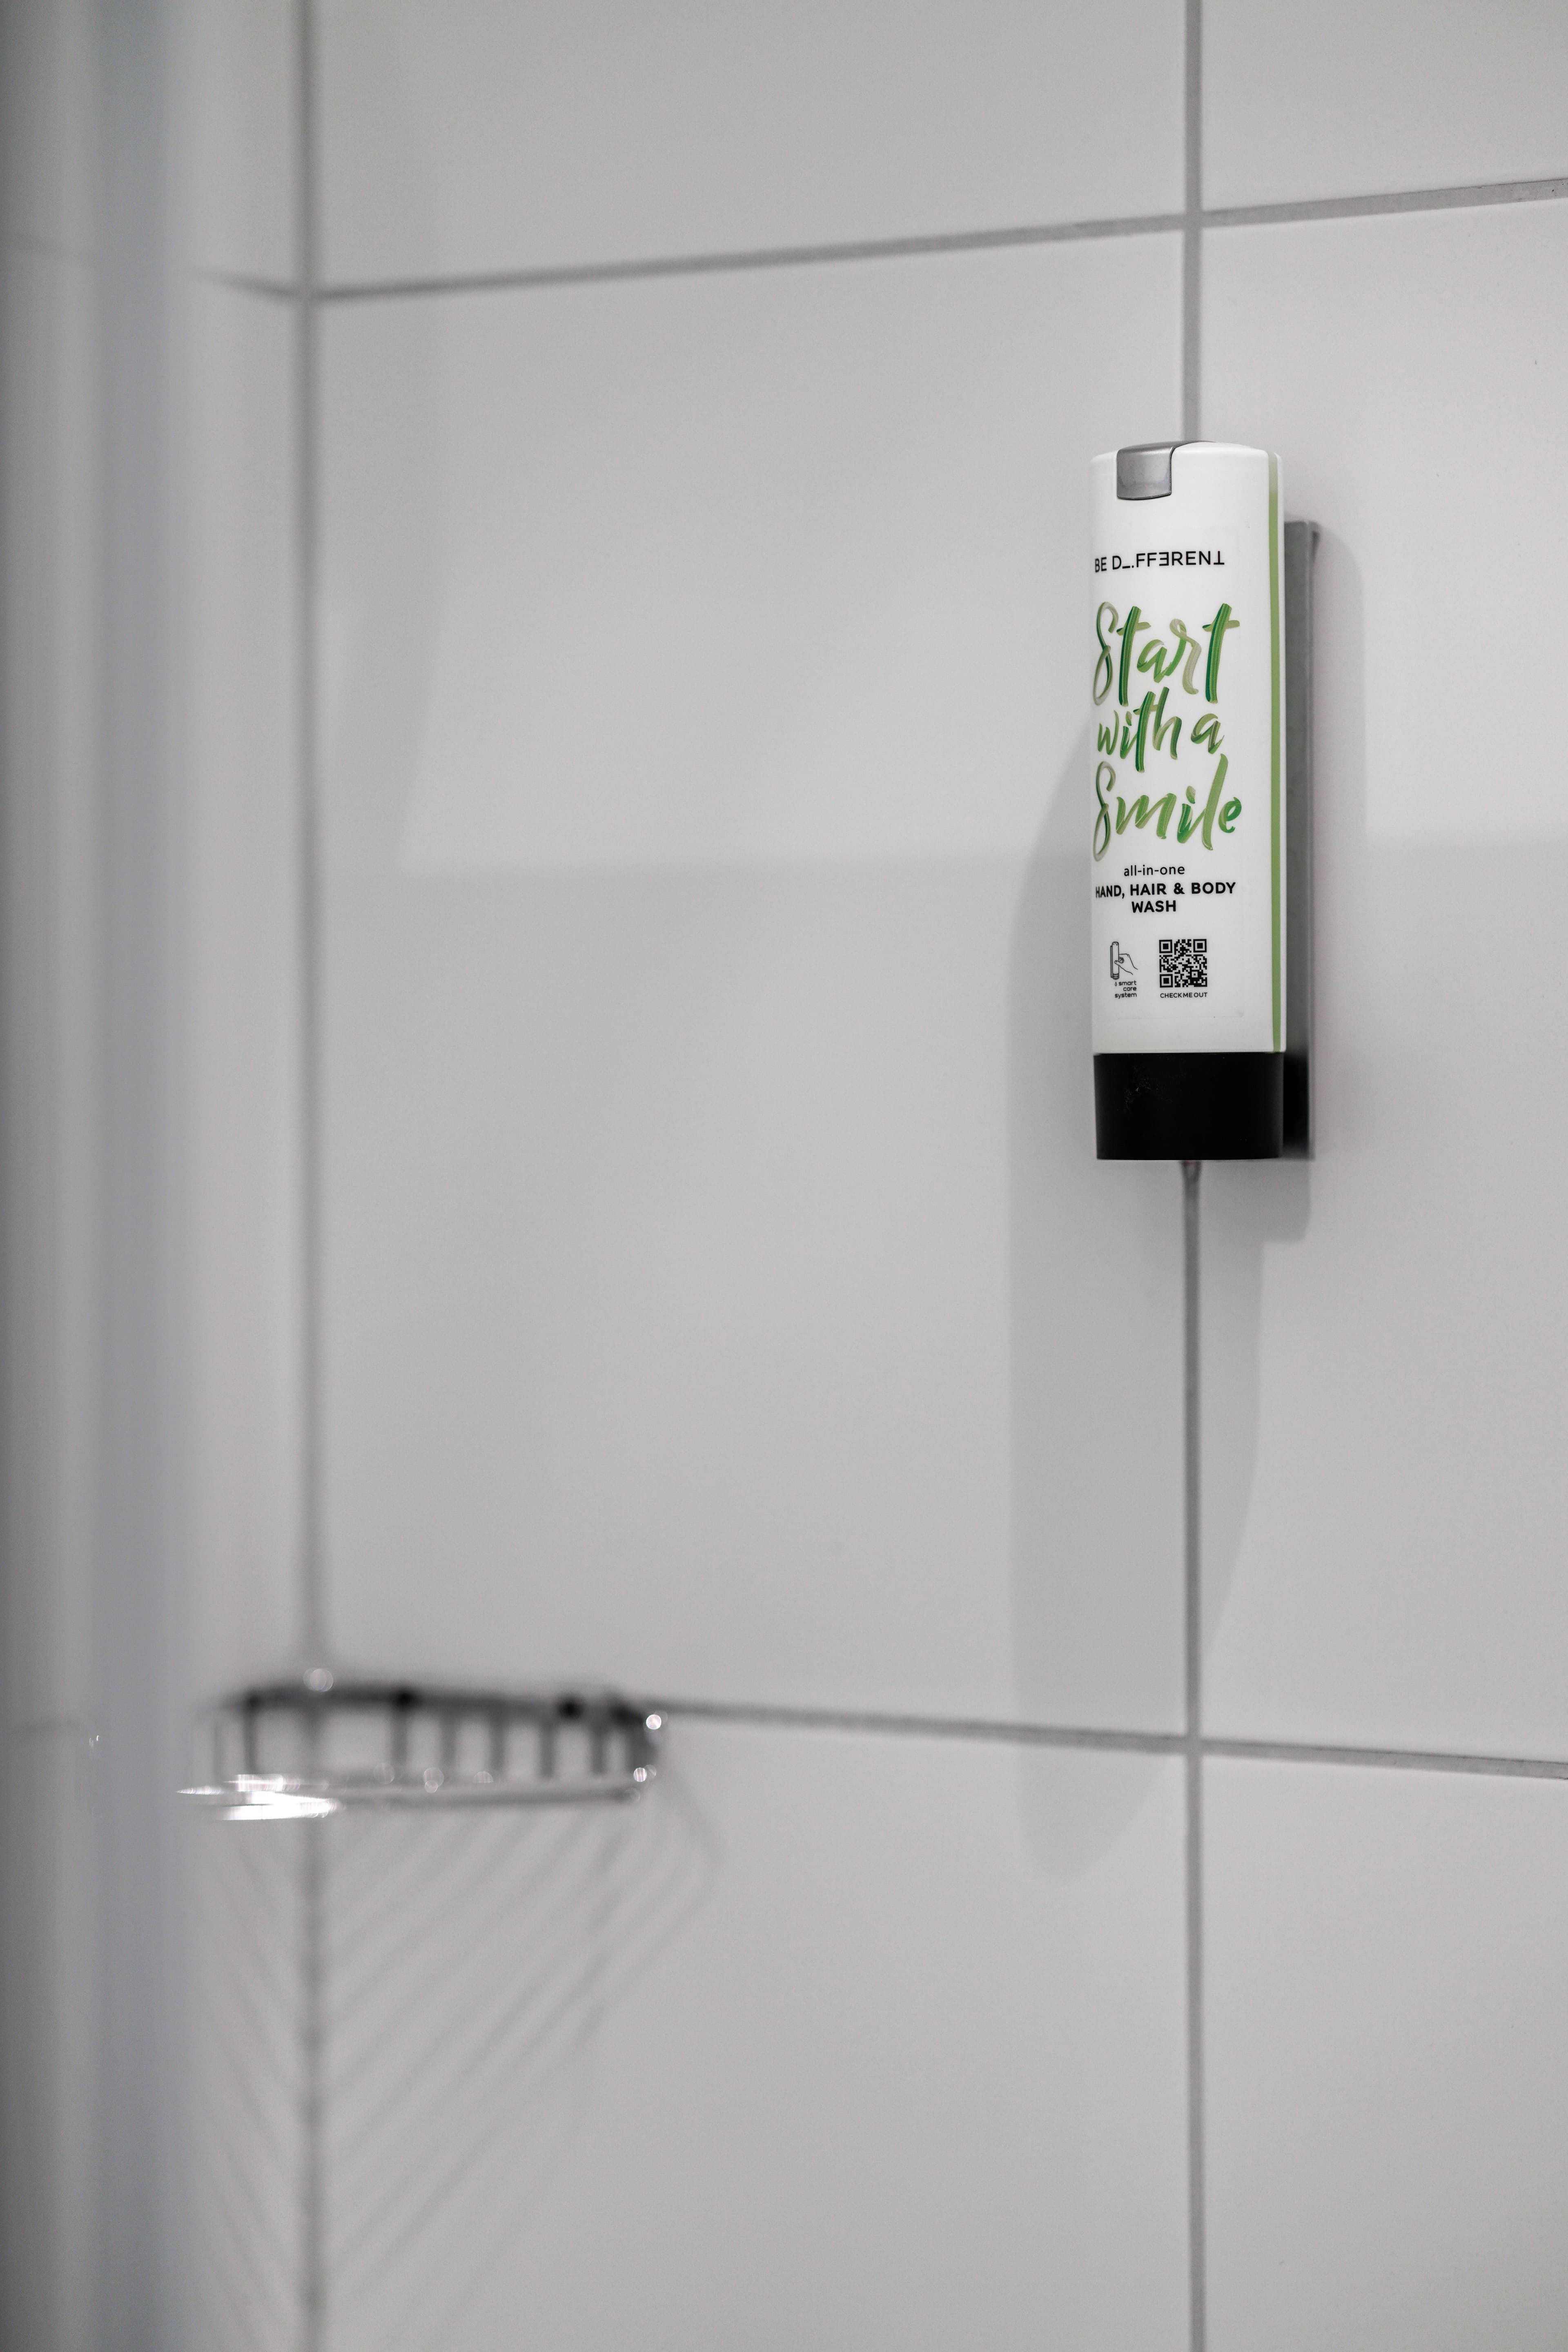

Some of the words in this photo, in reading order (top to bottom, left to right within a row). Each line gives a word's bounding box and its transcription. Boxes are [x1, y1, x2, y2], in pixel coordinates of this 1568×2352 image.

[1094, 556, 1107, 573] BE
[1092, 601, 1240, 706] Start
[1097, 686, 1182, 773] with
[1190, 713, 1225, 754] a
[1093, 753, 1242, 862] Smile
[1124, 864, 1185, 877] all-in-one
[1095, 884, 1125, 899] HAND,
[1130, 883, 1167, 896] HAIR
[1173, 882, 1185, 895] &
[1191, 882, 1236, 895] BODY
[1131, 900, 1177, 913] WASH
